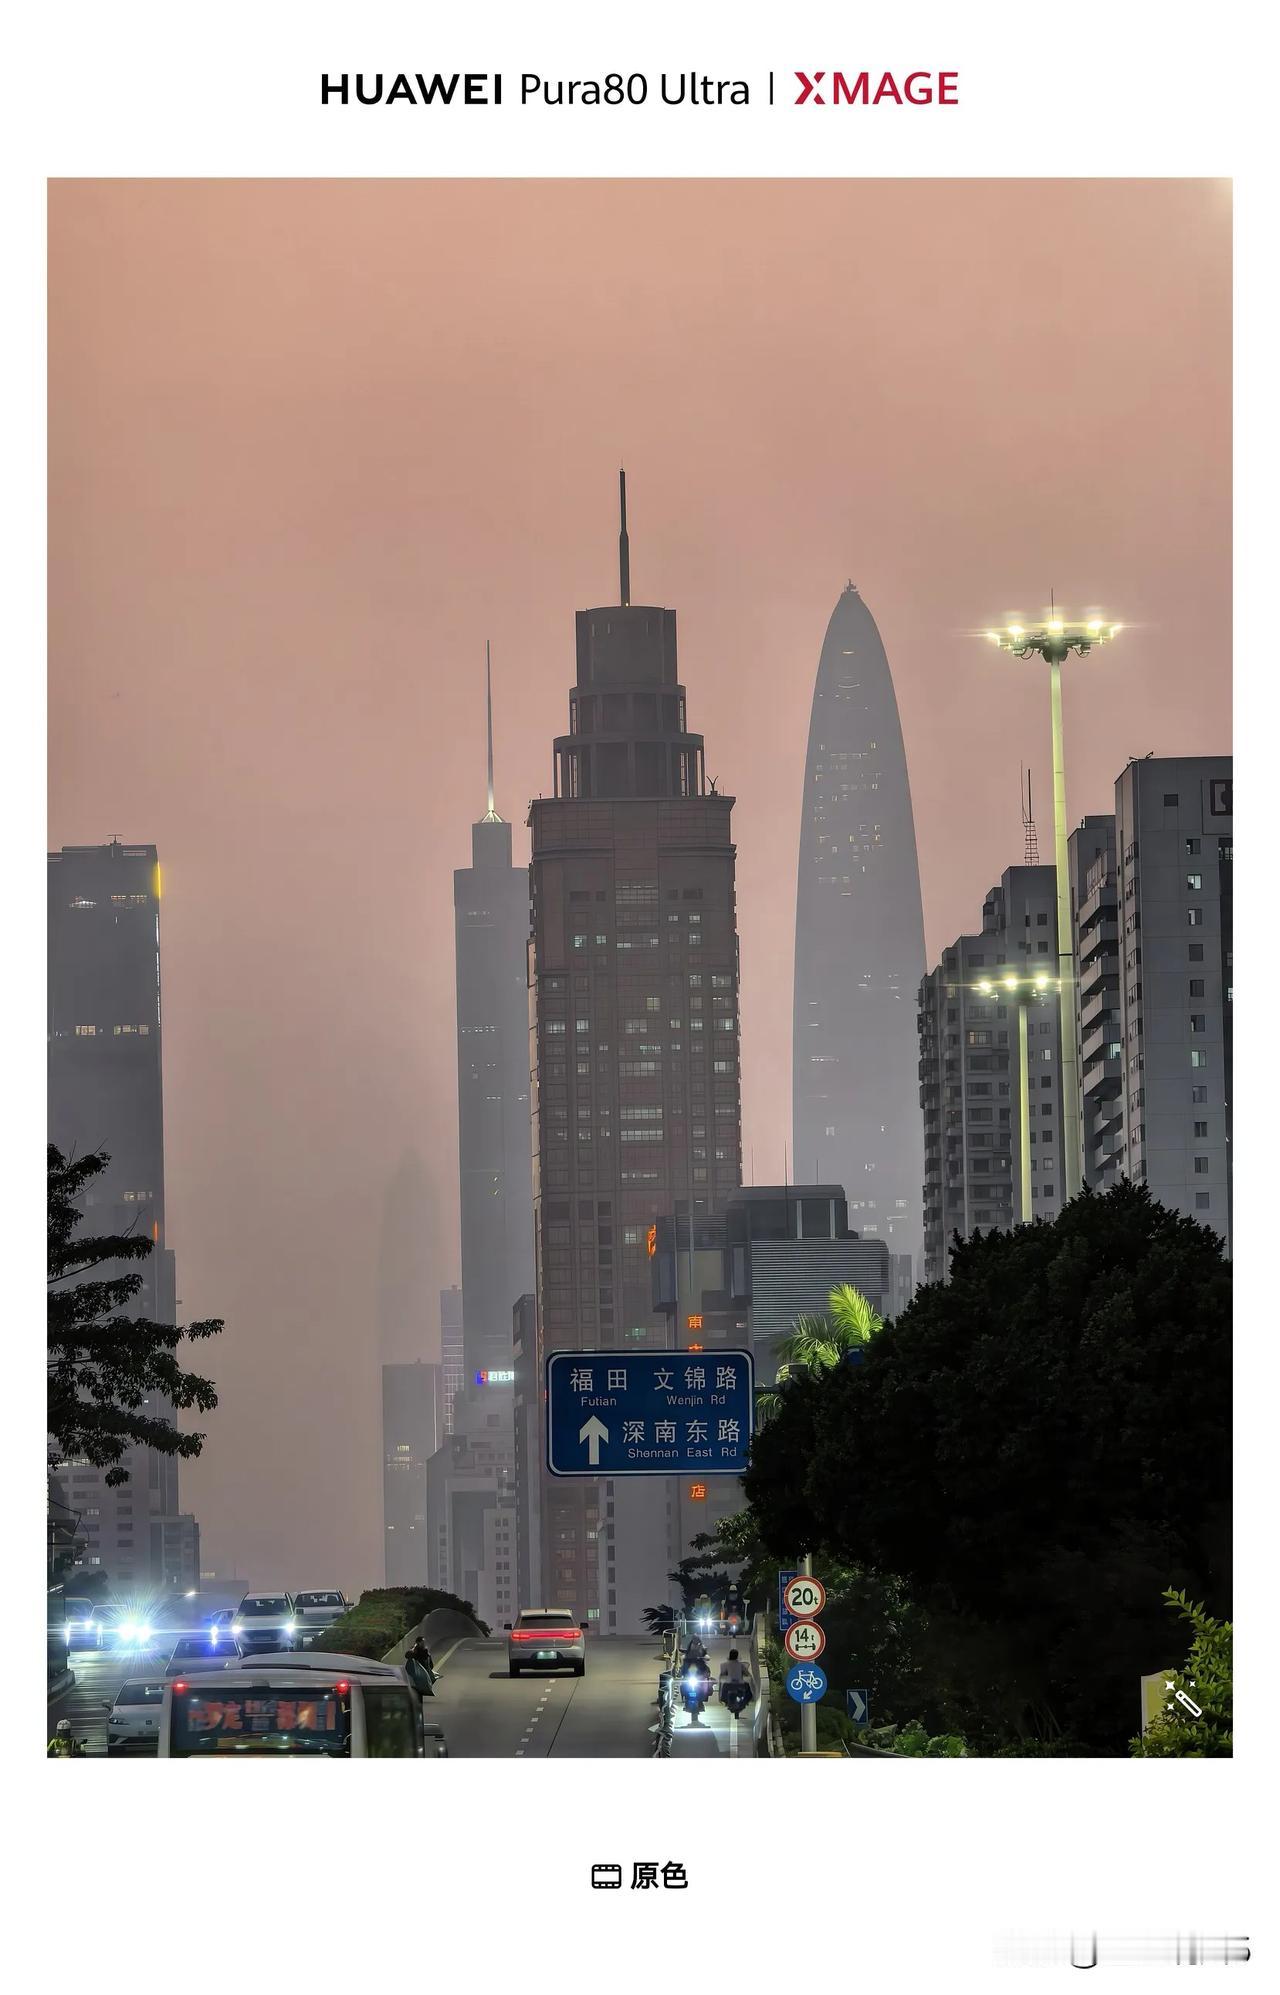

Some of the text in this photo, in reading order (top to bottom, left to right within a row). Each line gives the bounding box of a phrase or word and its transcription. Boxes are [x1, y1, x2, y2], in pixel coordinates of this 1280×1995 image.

[569, 1366, 737, 1392] 福田 文锦路
[581, 1396, 617, 1407] Futian
[666, 1394, 726, 1408] Wenjin Rd
[622, 1418, 741, 1444] 深南东路
[627, 1446, 737, 1459] Shennan East Rd
[791, 1587, 819, 1606] 20t
